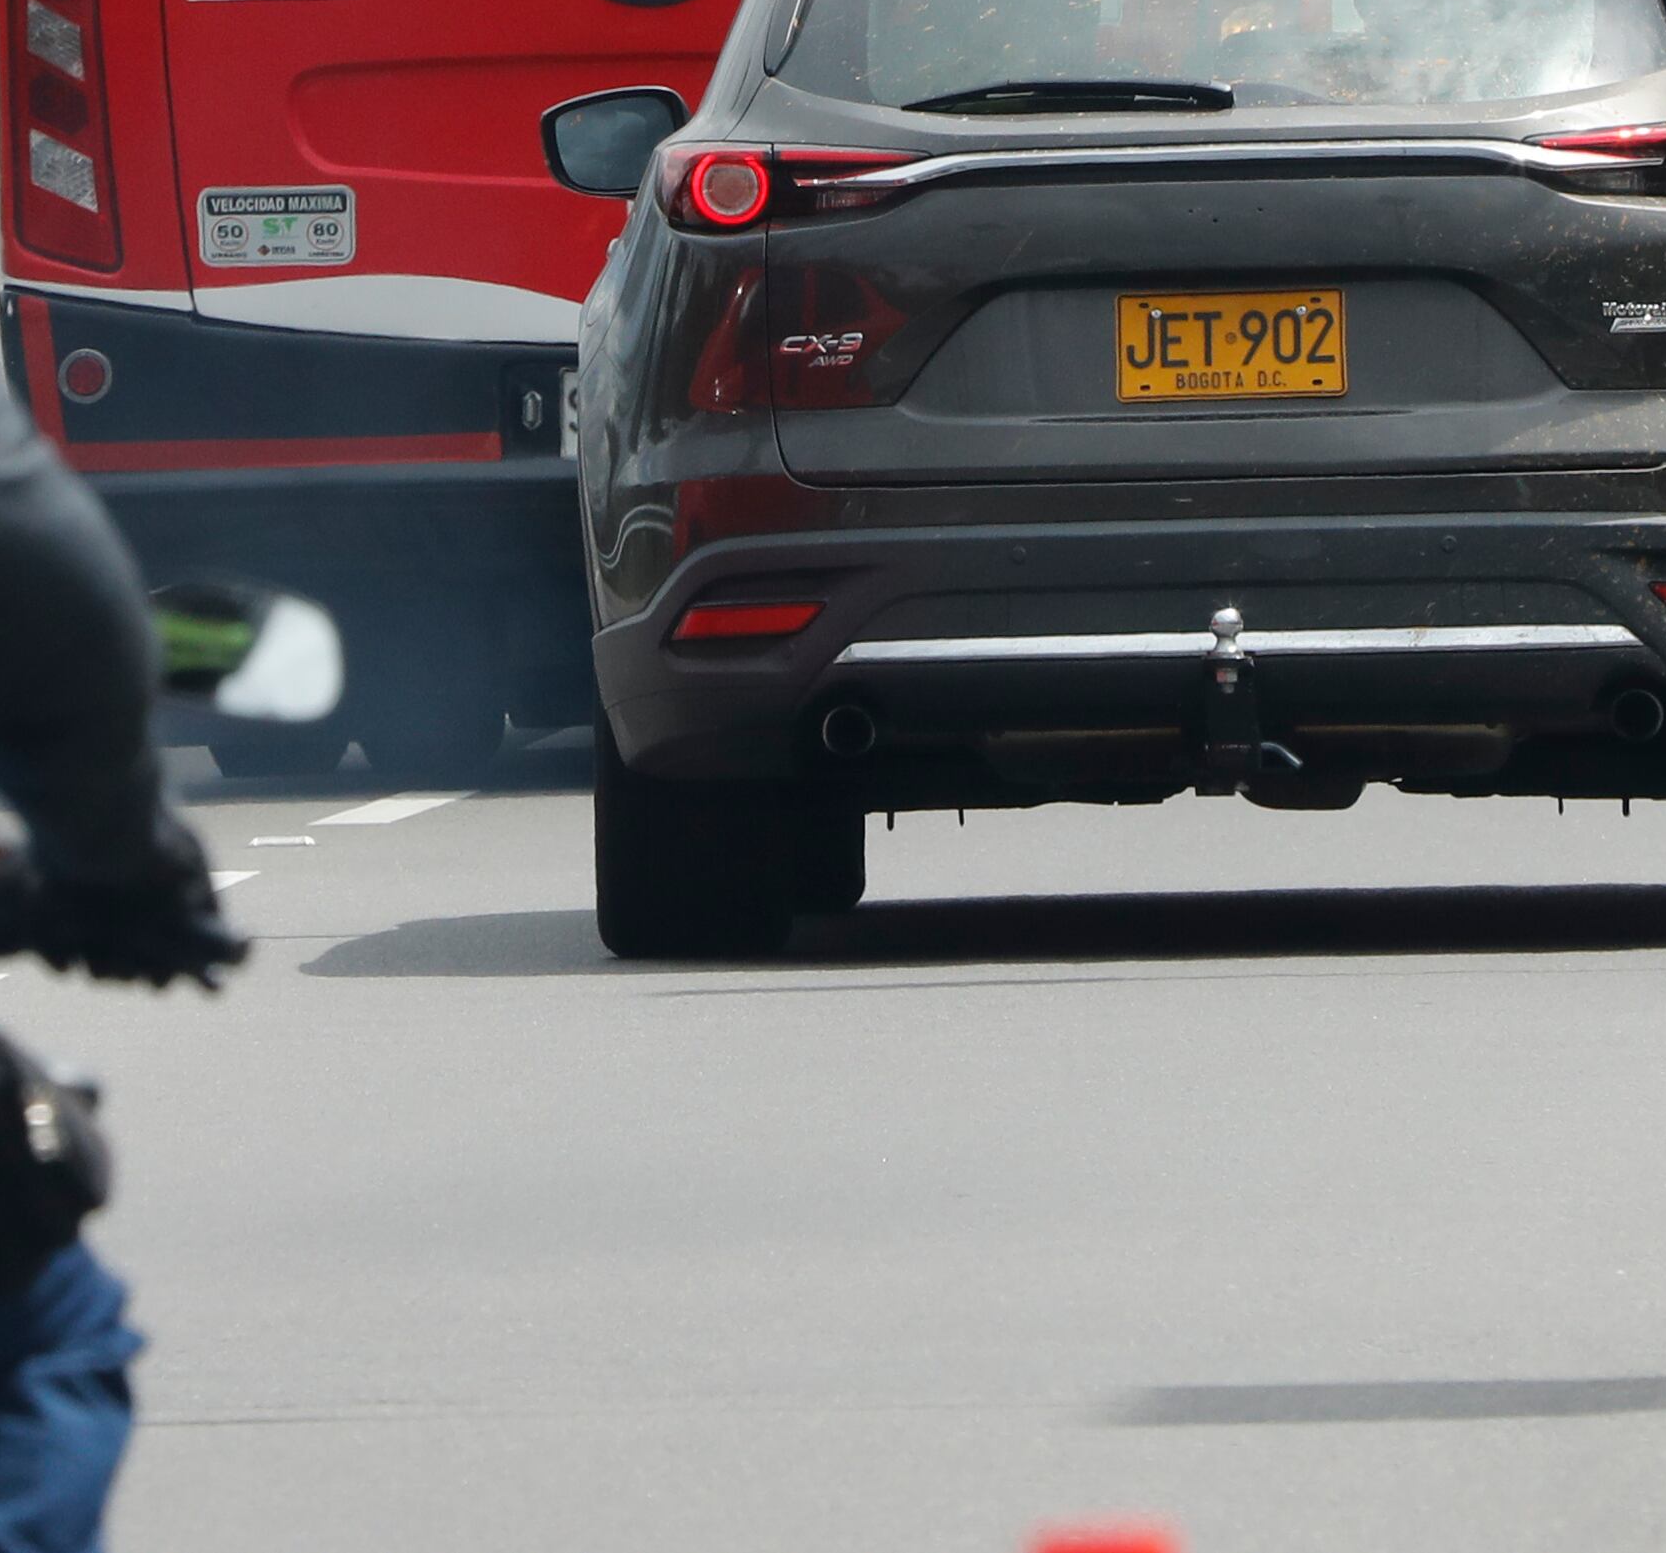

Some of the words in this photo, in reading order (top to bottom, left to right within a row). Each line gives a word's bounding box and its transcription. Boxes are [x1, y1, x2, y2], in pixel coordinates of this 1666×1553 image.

[210, 197, 286, 213] VELOCIDAD
[287, 195, 344, 212] MAXIMA
[217, 224, 244, 240] 50
[312, 222, 339, 238] 80
[779, 331, 864, 353] CX-9
[808, 354, 854, 368] AWD
[1175, 370, 1245, 390] BOGOTA
[1256, 369, 1288, 389] D.C.
